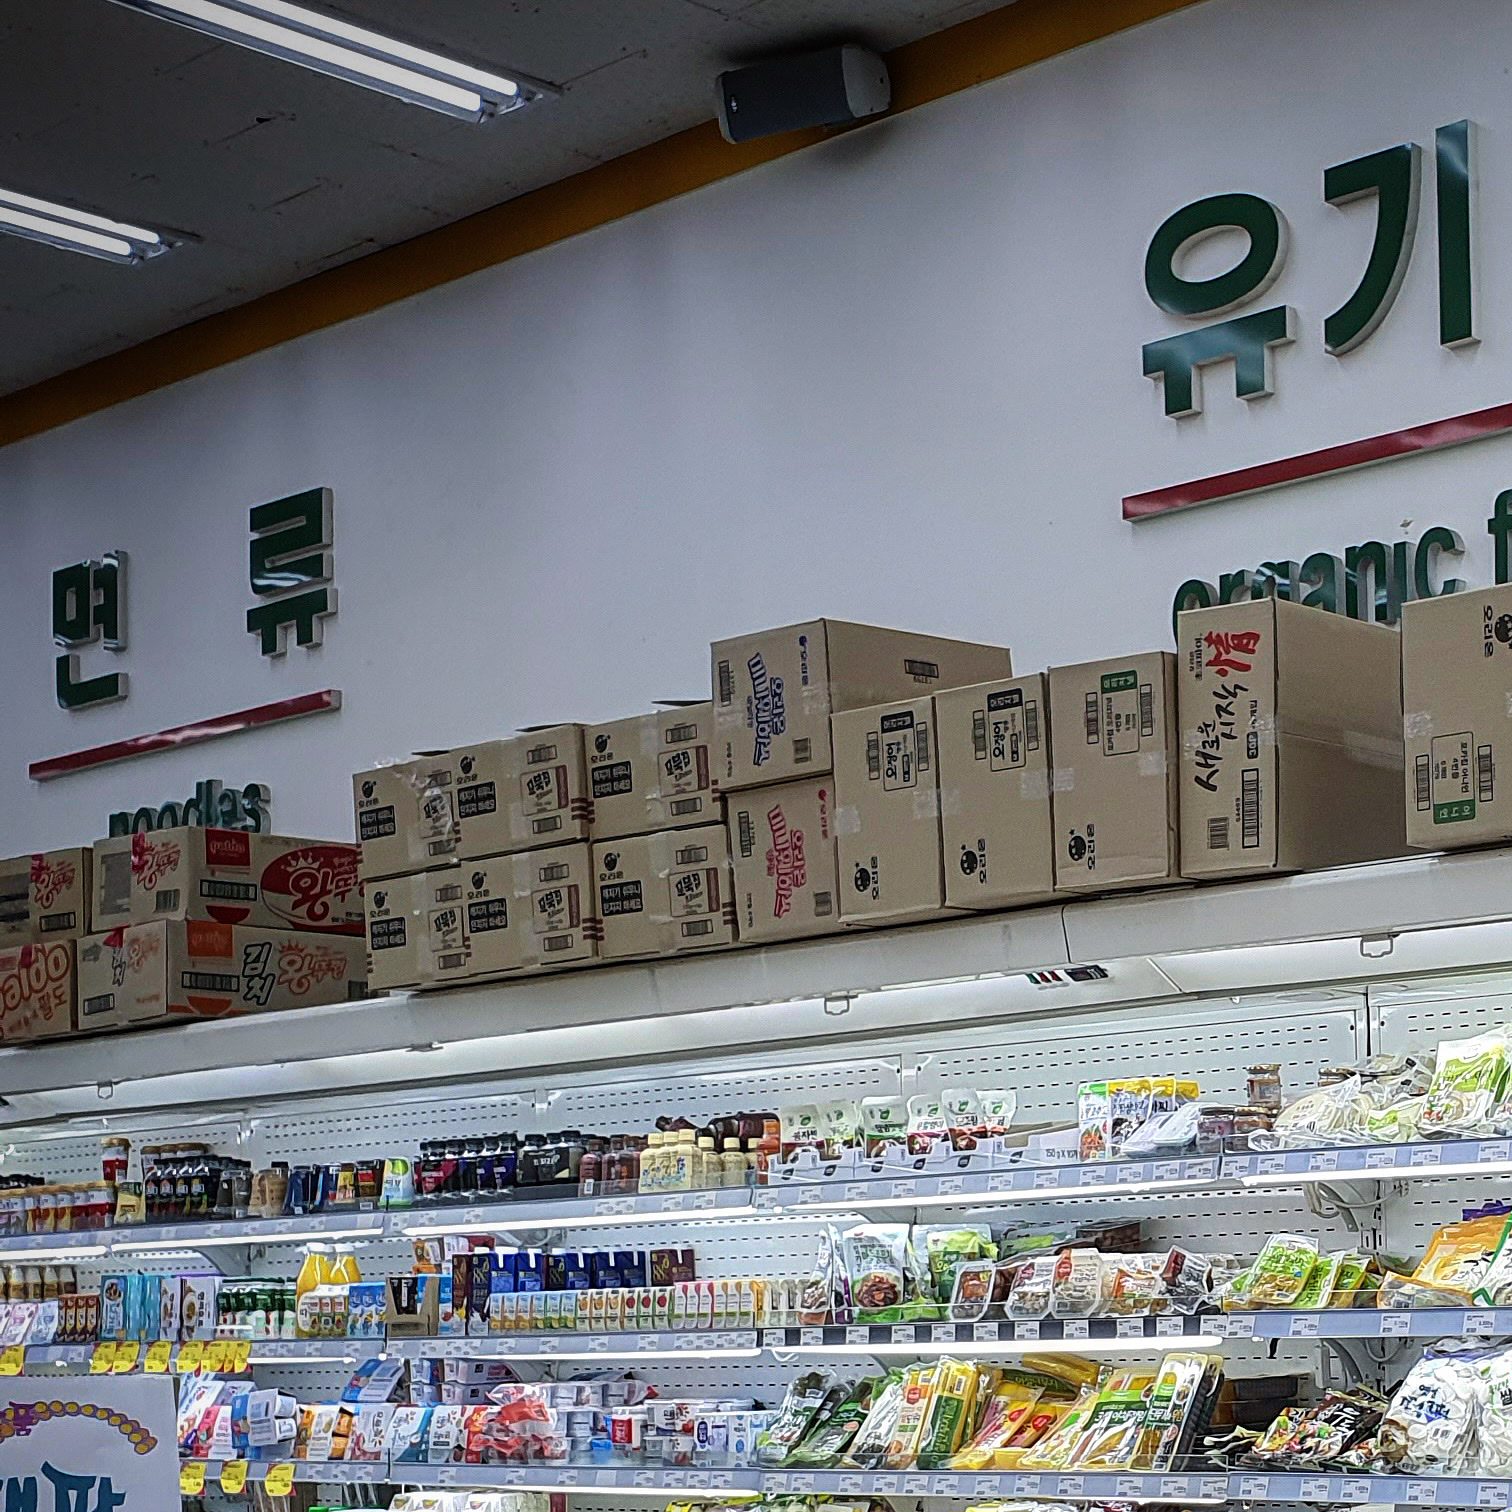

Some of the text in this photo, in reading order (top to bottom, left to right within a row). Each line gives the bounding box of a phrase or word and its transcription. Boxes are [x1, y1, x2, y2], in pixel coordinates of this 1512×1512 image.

[1203, 631, 1262, 677] 情
[1483, 605, 1494, 658] 오리온
[747, 652, 772, 767] 미미웨하스
[769, 676, 786, 736] 오리온
[1212, 683, 1249, 740] 시작
[883, 741, 899, 781] 오징어
[991, 719, 1006, 760] 오징어
[1194, 719, 1224, 793] 새로운
[1438, 804, 1471, 819] 어니언
[766, 804, 792, 919] 미미웨하스
[789, 829, 807, 888] 오리온
[977, 837, 987, 884] 오리온
[1086, 822, 1096, 871] 오리온
[289, 865, 366, 923] 왕뚜
[870, 855, 879, 900] 오리온
[0, 942, 71, 1016] aldo
[242, 941, 276, 1006] 김치
